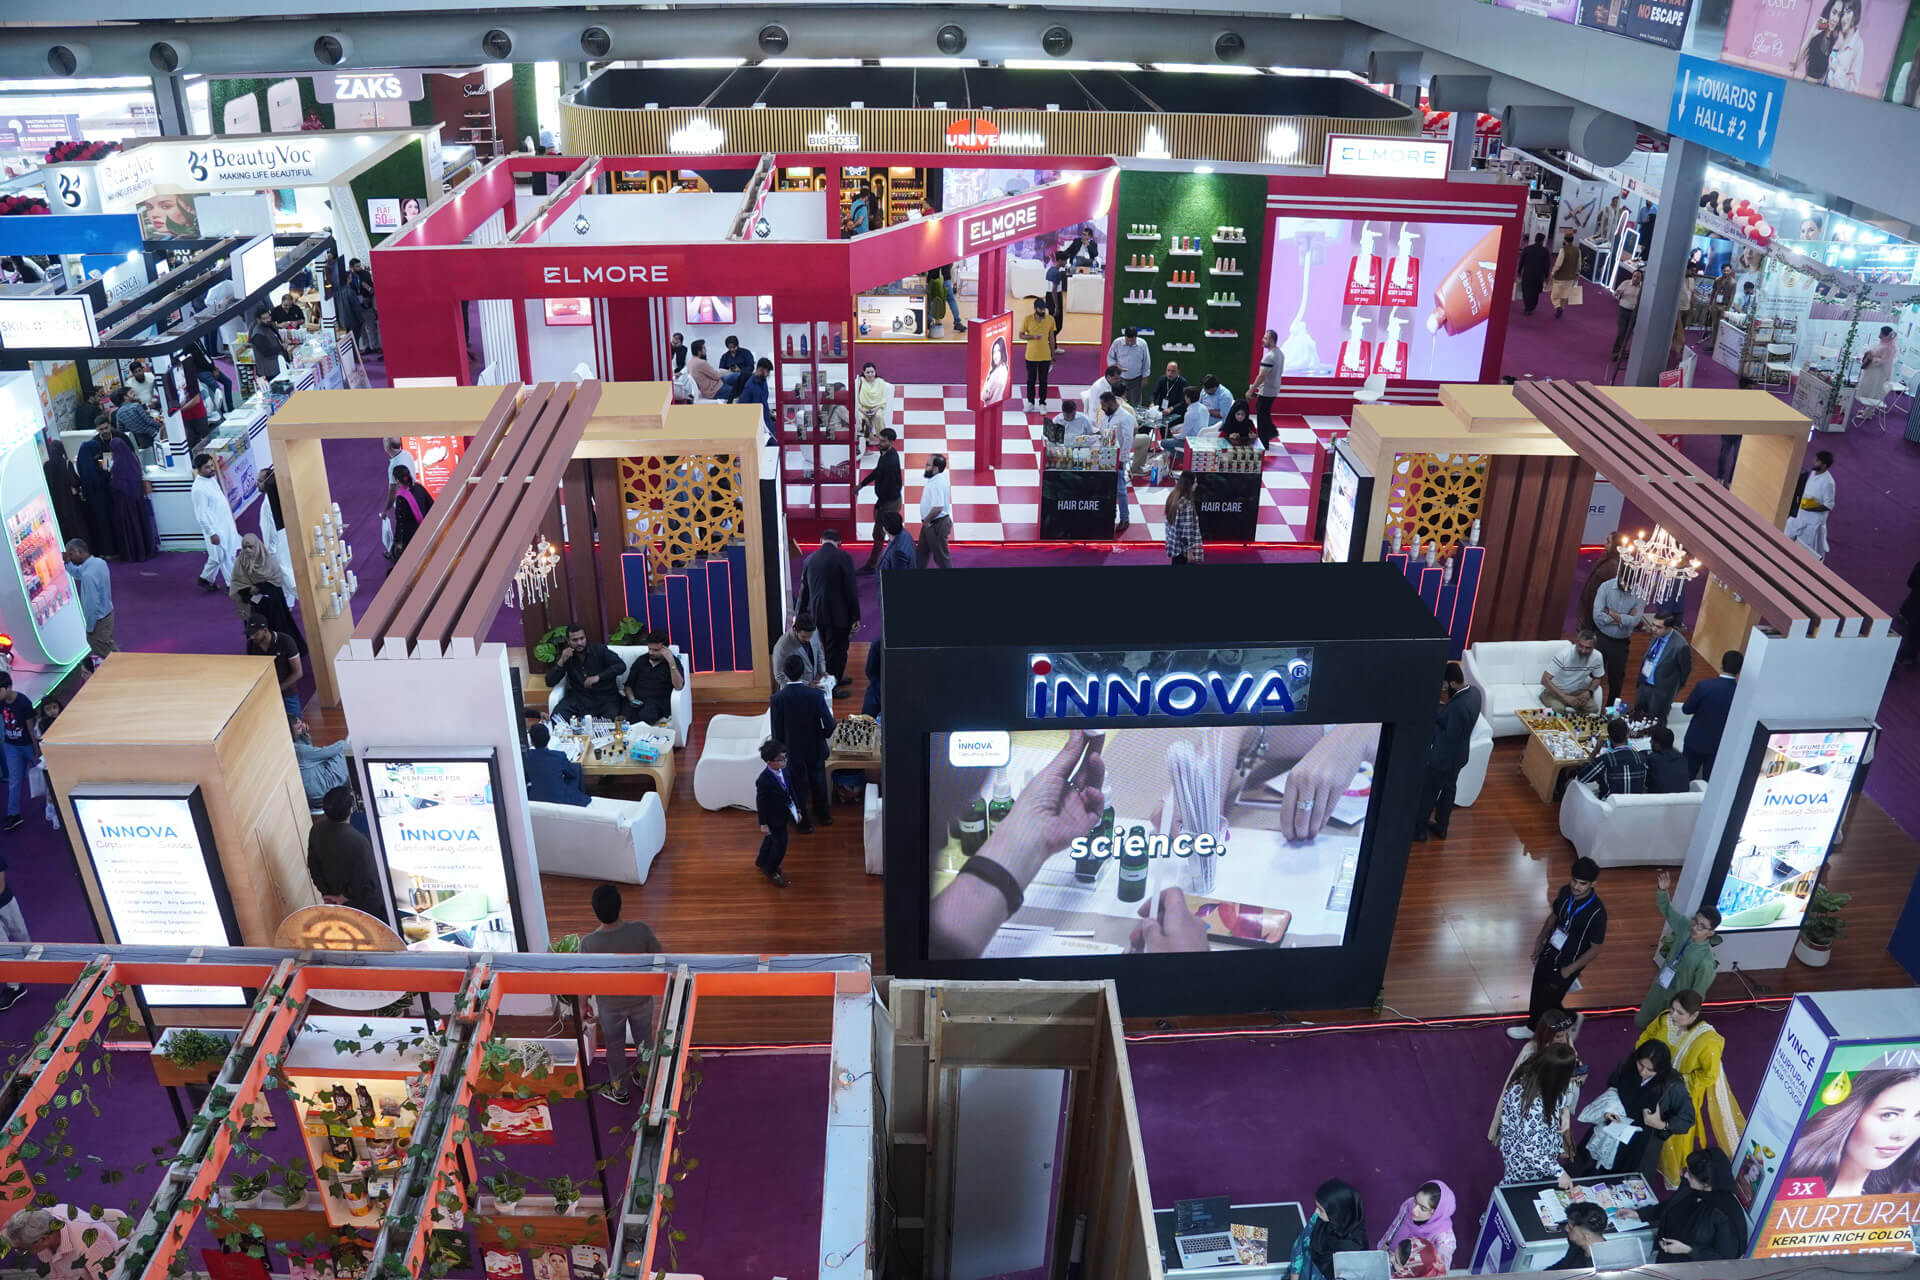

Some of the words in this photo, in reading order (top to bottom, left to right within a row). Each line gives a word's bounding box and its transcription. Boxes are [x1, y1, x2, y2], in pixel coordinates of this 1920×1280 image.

[1637, 3, 1650, 19] NO
[1650, 5, 1684, 27] ESCAPE
[335, 77, 402, 99] ZAKS
[1696, 76, 1757, 112] TOWARDS
[1694, 106, 1725, 134] HALL
[1727, 116, 1738, 137] #
[1736, 119, 1747, 141] 2
[808, 136, 827, 145] BIG
[828, 135, 859, 145] BOSS
[1341, 147, 1437, 164] ELMORE
[219, 172, 251, 181] MAKING
[252, 171, 268, 179] LIFE
[270, 168, 313, 178] BEAUTIFUL
[970, 205, 1037, 240] ELMORE
[543, 265, 669, 283] ELMORE
[1057, 500, 1077, 511] HAIR
[1078, 500, 1100, 511] CARE
[1201, 502, 1221, 512] HAIR
[1221, 502, 1242, 513] CARE
[1070, 826, 1226, 860] science.
[1787, 1027, 1815, 1072] VINCÉ
[1777, 1047, 1808, 1094] NURTURAL
[1772, 1063, 1785, 1082] HAIR
[1783, 1080, 1803, 1106] COLOR
[1787, 1181, 1816, 1197] 3X
[1775, 1200, 1920, 1230] NURTURAL
[1771, 1233, 1830, 1246] KERATIN
[1832, 1231, 1865, 1242] RICH
[1868, 1230, 1911, 1240] COLOR
